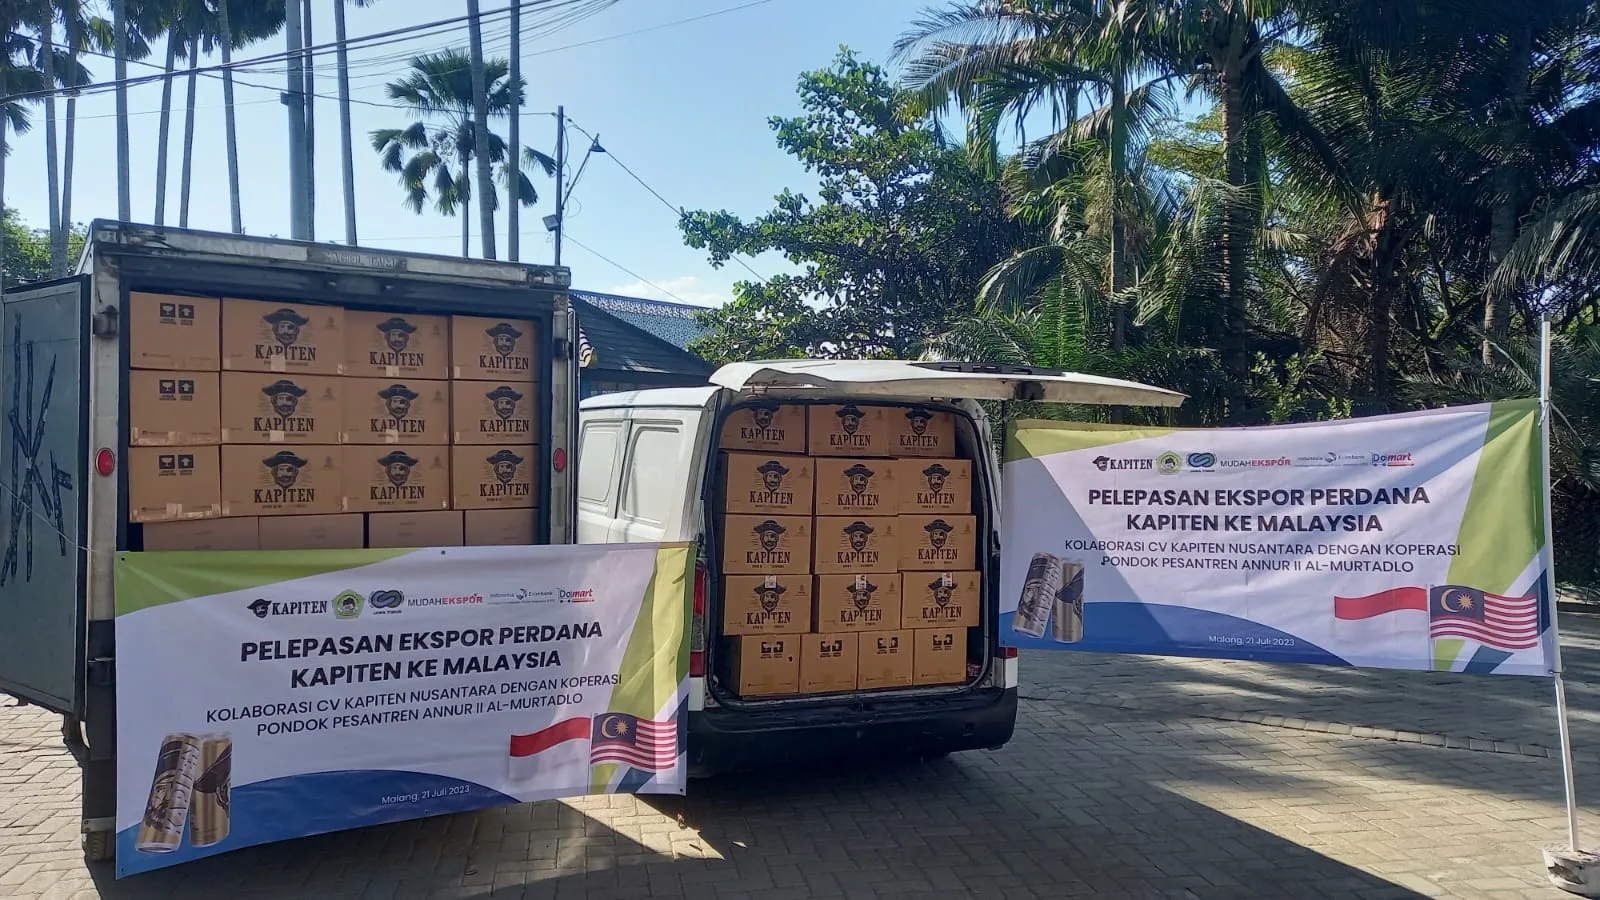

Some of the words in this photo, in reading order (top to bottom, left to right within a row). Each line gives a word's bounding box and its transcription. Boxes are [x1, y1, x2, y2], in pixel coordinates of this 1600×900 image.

[370, 351, 424, 367] KAPITEN
[479, 355, 529, 370] KAPITEN
[253, 416, 314, 432] KAPITEN
[370, 418, 425, 433] KAPITEN
[479, 419, 529, 432] KAPITEN
[741, 427, 785, 441] KAPITEN
[830, 433, 871, 446] KAPITEN
[899, 434, 938, 447] KAPITEN
[1110, 459, 1153, 470] KAPITEN
[254, 488, 315, 503] KAPITEN
[370, 485, 425, 500] KAPITEN
[479, 483, 529, 497] KAPITEN
[750, 490, 793, 505] KAPITEN
[1088, 489, 1209, 506] PELEPASAN
[1215, 489, 1305, 506] EKSPOR
[1310, 487, 1431, 506] PERDANA
[837, 493, 879, 506] KAPITEN
[916, 492, 955, 504] KAPITEN
[1127, 514, 1219, 531] KAPITEN
[1224, 515, 1252, 531] KE
[1257, 514, 1383, 532] MALAYSIA
[918, 548, 958, 560] KAPITEN
[1065, 539, 1145, 552] KOLABORASI
[1148, 542, 1168, 553] CV
[1171, 542, 1226, 554] KAPITEN
[1229, 543, 1314, 555] NUSANTARA
[1318, 543, 1381, 555] DENGAN
[1385, 543, 1461, 556] KOPERASI
[746, 551, 791, 564] KAPITEN
[837, 551, 879, 564] KAPITEN
[1103, 556, 1159, 568] PONDOK
[1162, 557, 1238, 570] PESANTREN
[1241, 559, 1290, 571] ANNUR
[1294, 560, 1301, 571] II
[1305, 560, 1414, 573] AL-MURTADLO
[271, 600, 328, 616] KAPITEN
[922, 606, 962, 619] KAPITEN
[746, 611, 791, 625] KAPITEN
[840, 609, 882, 623] KAPITEN
[241, 633, 393, 662] PELEPASAN
[399, 628, 494, 651] EKSPOR
[499, 621, 603, 645] PERDANA
[1256, 637, 1271, 645] Juli
[1273, 638, 1295, 646] 2023
[291, 661, 401, 688] KAPITEN
[407, 658, 438, 679] KE
[443, 650, 561, 676] MALAYSIA
[206, 701, 312, 723] KOLABORASI
[316, 698, 341, 712] CV
[344, 691, 406, 710] KAPITEN
[410, 683, 497, 703] NUSANTARA
[500, 679, 557, 695] DENGAN
[560, 673, 622, 688] KOPERASI
[257, 717, 328, 736] PONDOK
[332, 709, 419, 729] PESANTREN
[422, 702, 473, 720] ANNUR
[476, 702, 484, 714] II
[486, 693, 583, 712] AL-MURTADLO
[421, 790, 430, 799] 21
[431, 787, 447, 798] Juli
[449, 784, 470, 795] 2023
